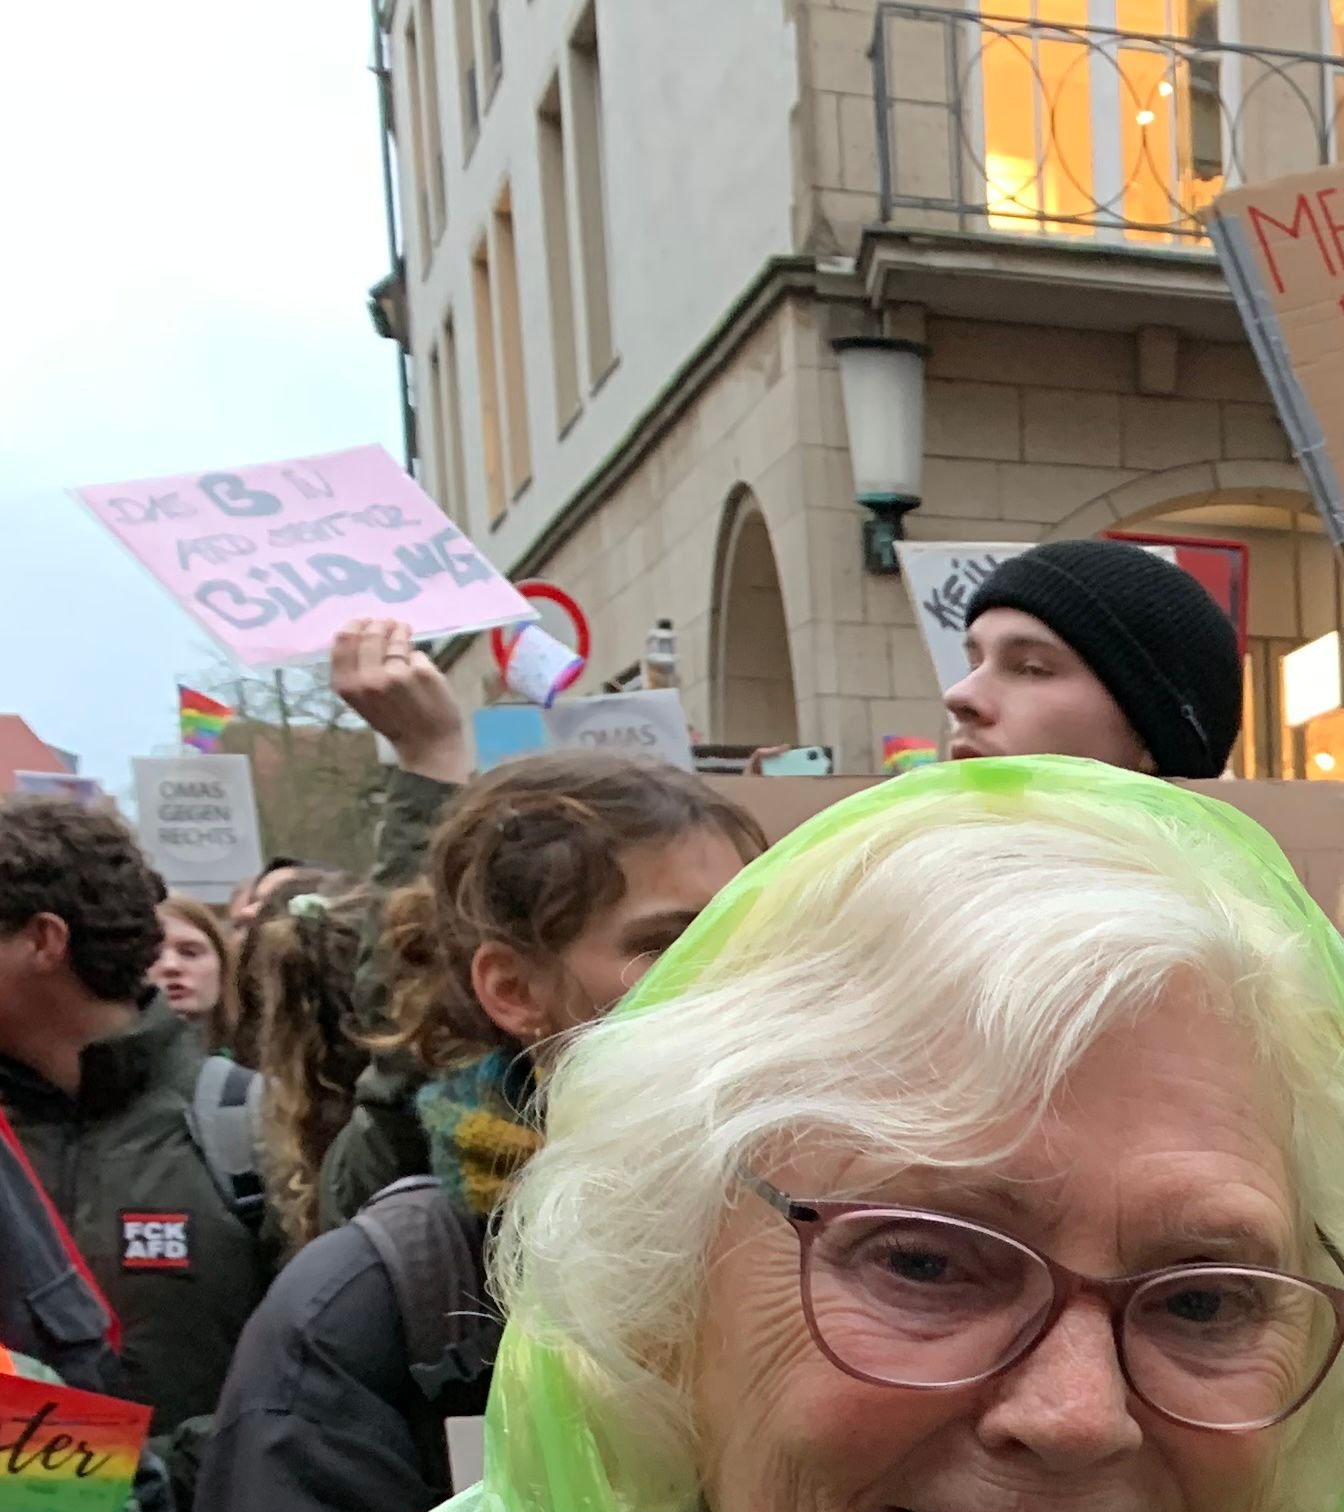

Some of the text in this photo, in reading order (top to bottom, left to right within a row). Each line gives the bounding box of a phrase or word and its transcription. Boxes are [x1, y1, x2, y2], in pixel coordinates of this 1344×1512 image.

[123, 1221, 187, 1240] FCK
[124, 1239, 188, 1258] AFD
[0, 1402, 112, 1478] ter
